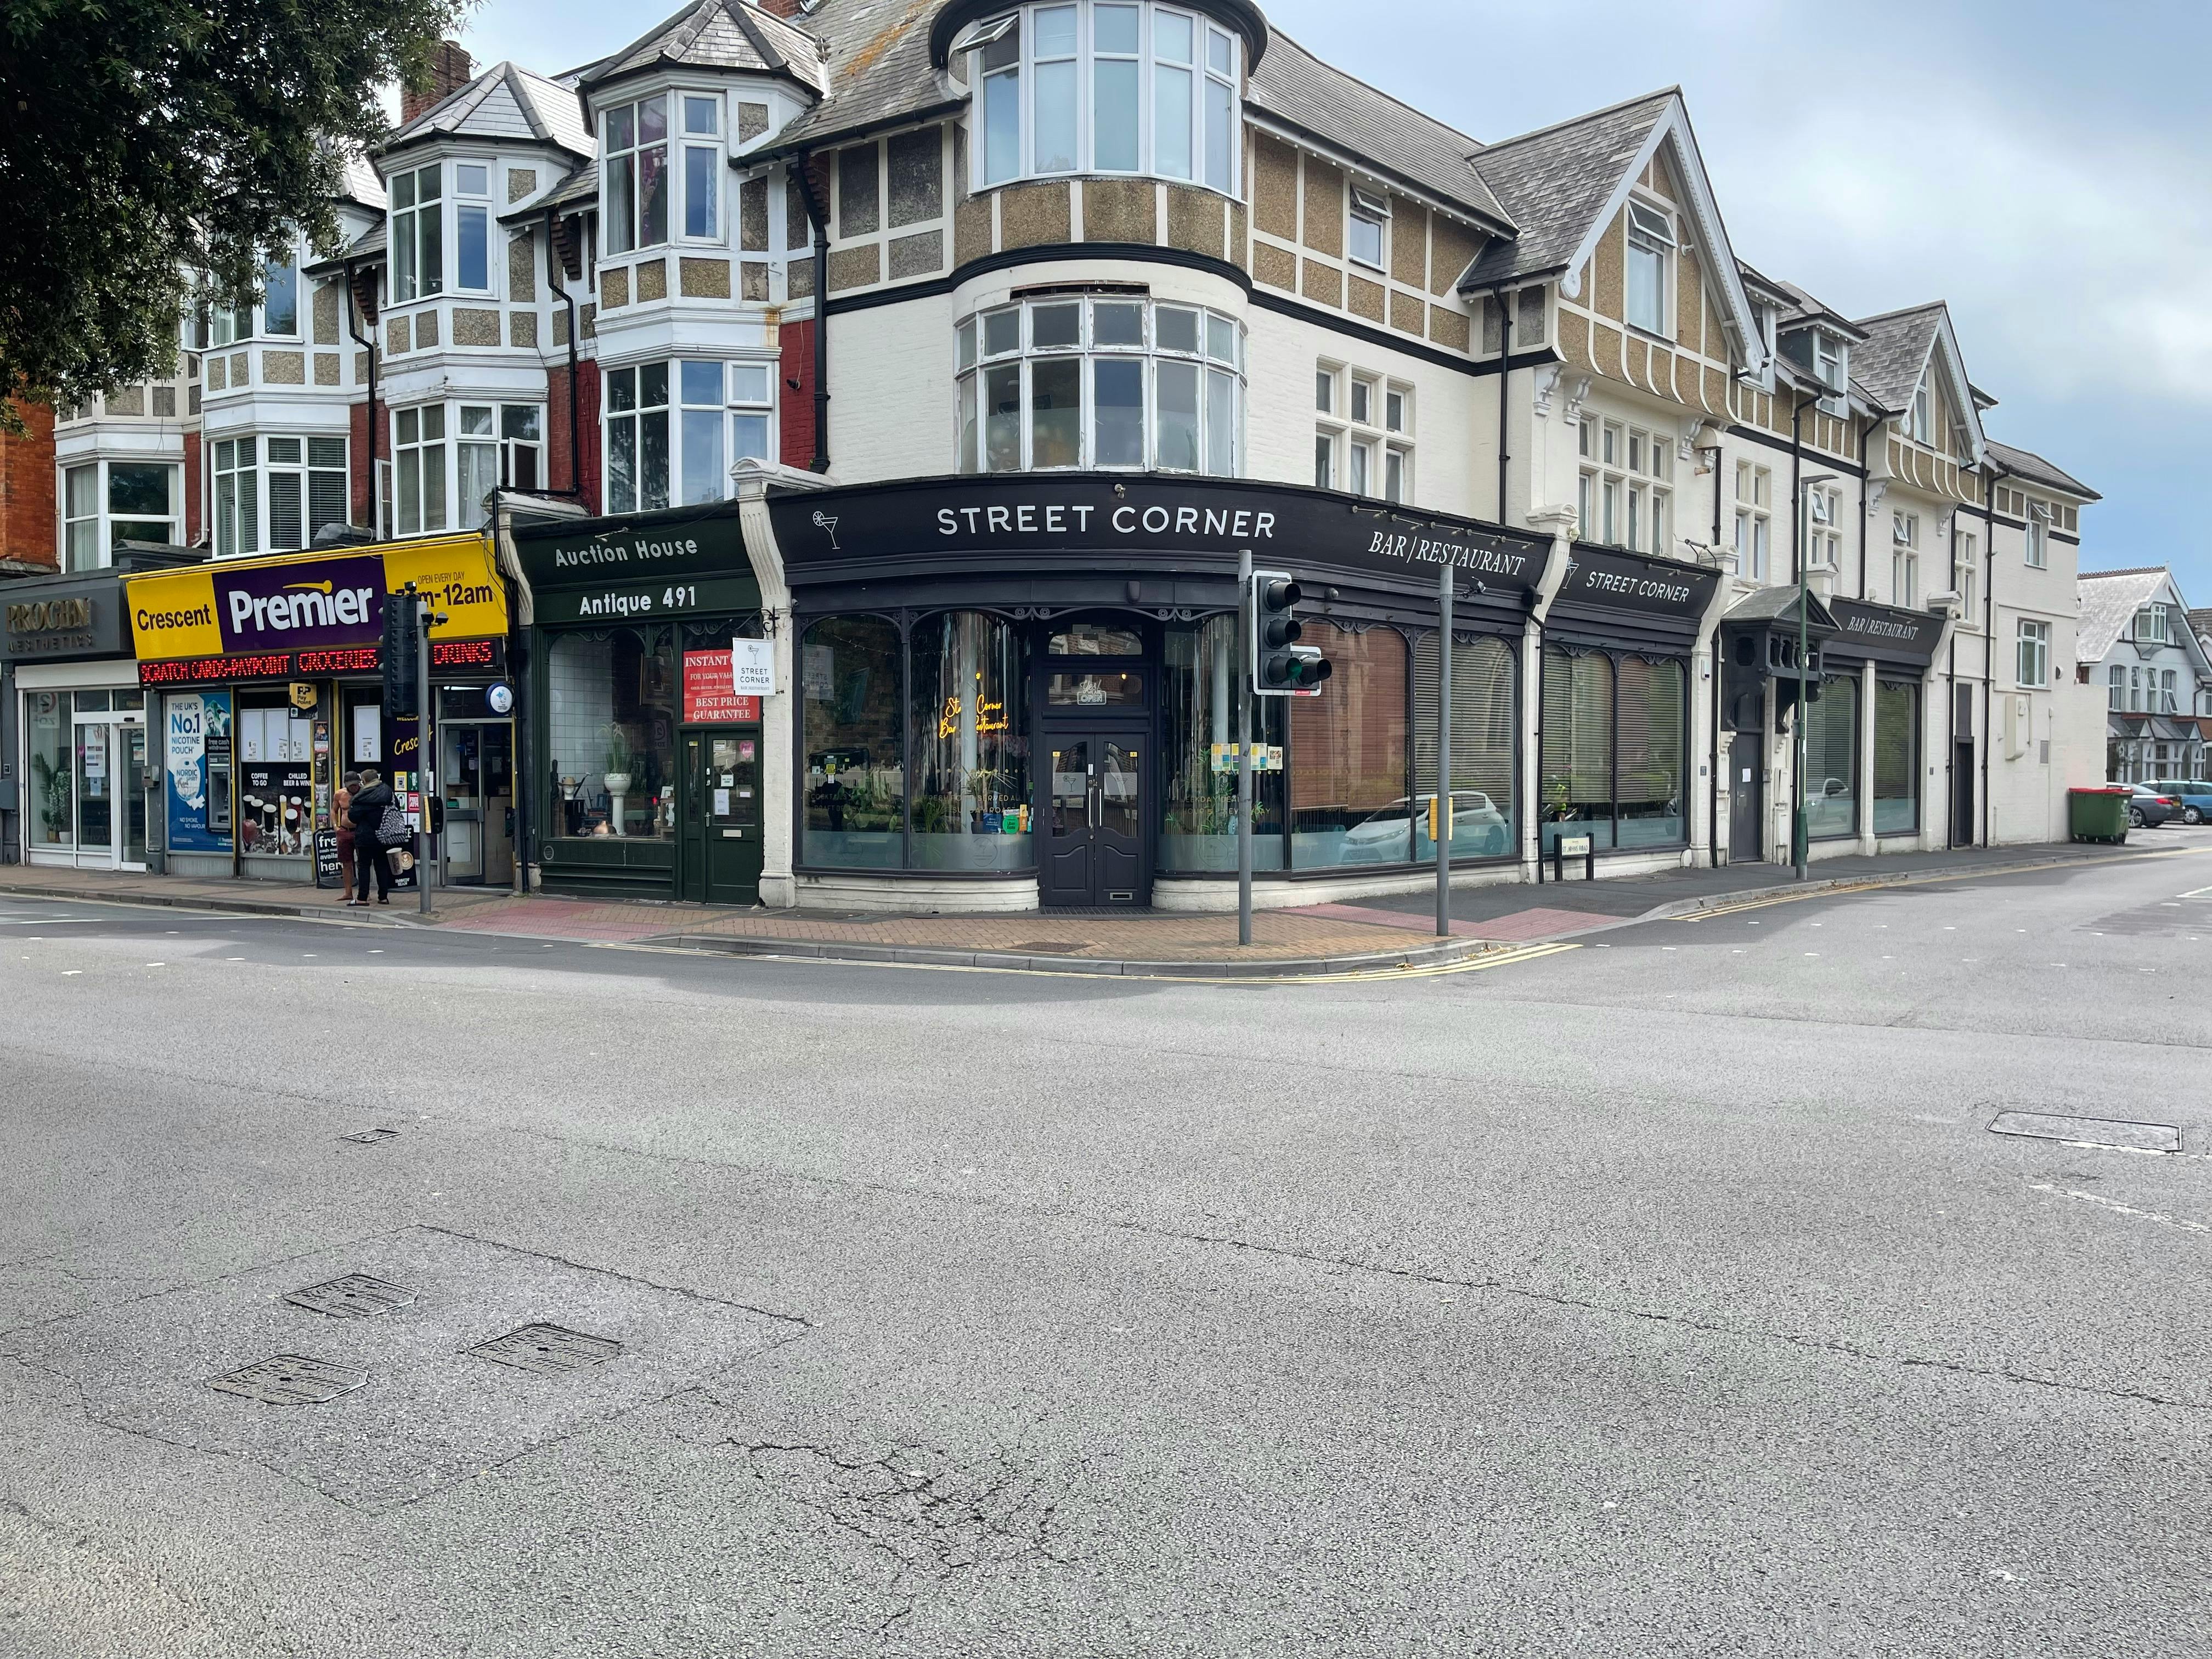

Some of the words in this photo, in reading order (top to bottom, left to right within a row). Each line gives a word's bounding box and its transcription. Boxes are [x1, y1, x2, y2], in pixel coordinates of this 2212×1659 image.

[937, 505, 1094, 535] STREET
[1112, 506, 1276, 539] CORNER
[555, 544, 628, 567] Auction
[635, 539, 698, 560] House
[417, 575, 433, 585] OPEN
[435, 573, 452, 583] EVERY
[454, 572, 465, 581] DAY
[1586, 571, 1638, 595] STREET
[1639, 580, 1690, 603] CORNER
[228, 586, 373, 634] Premier
[579, 592, 652, 616] Antique
[662, 585, 696, 608] 491
[136, 604, 212, 631] Crescent
[8, 633, 93, 652] AESTHETICS
[433, 641, 492, 665] DRINKS
[299, 649, 377, 672] GROCERIES
[685, 656, 729, 667] INSTANT
[141, 662, 188, 682] SCRATCH
[171, 702, 183, 711] THE
[184, 702, 198, 710] UK'S
[696, 698, 719, 707] BEST
[721, 697, 749, 707] PRICE
[977, 693, 1002, 714] Corner
[172, 713, 200, 734] No.1
[693, 709, 751, 720] GUARANTEE
[939, 717, 957, 739] Bar
[172, 736, 200, 744] NICOTINE
[319, 836, 337, 848] fre
